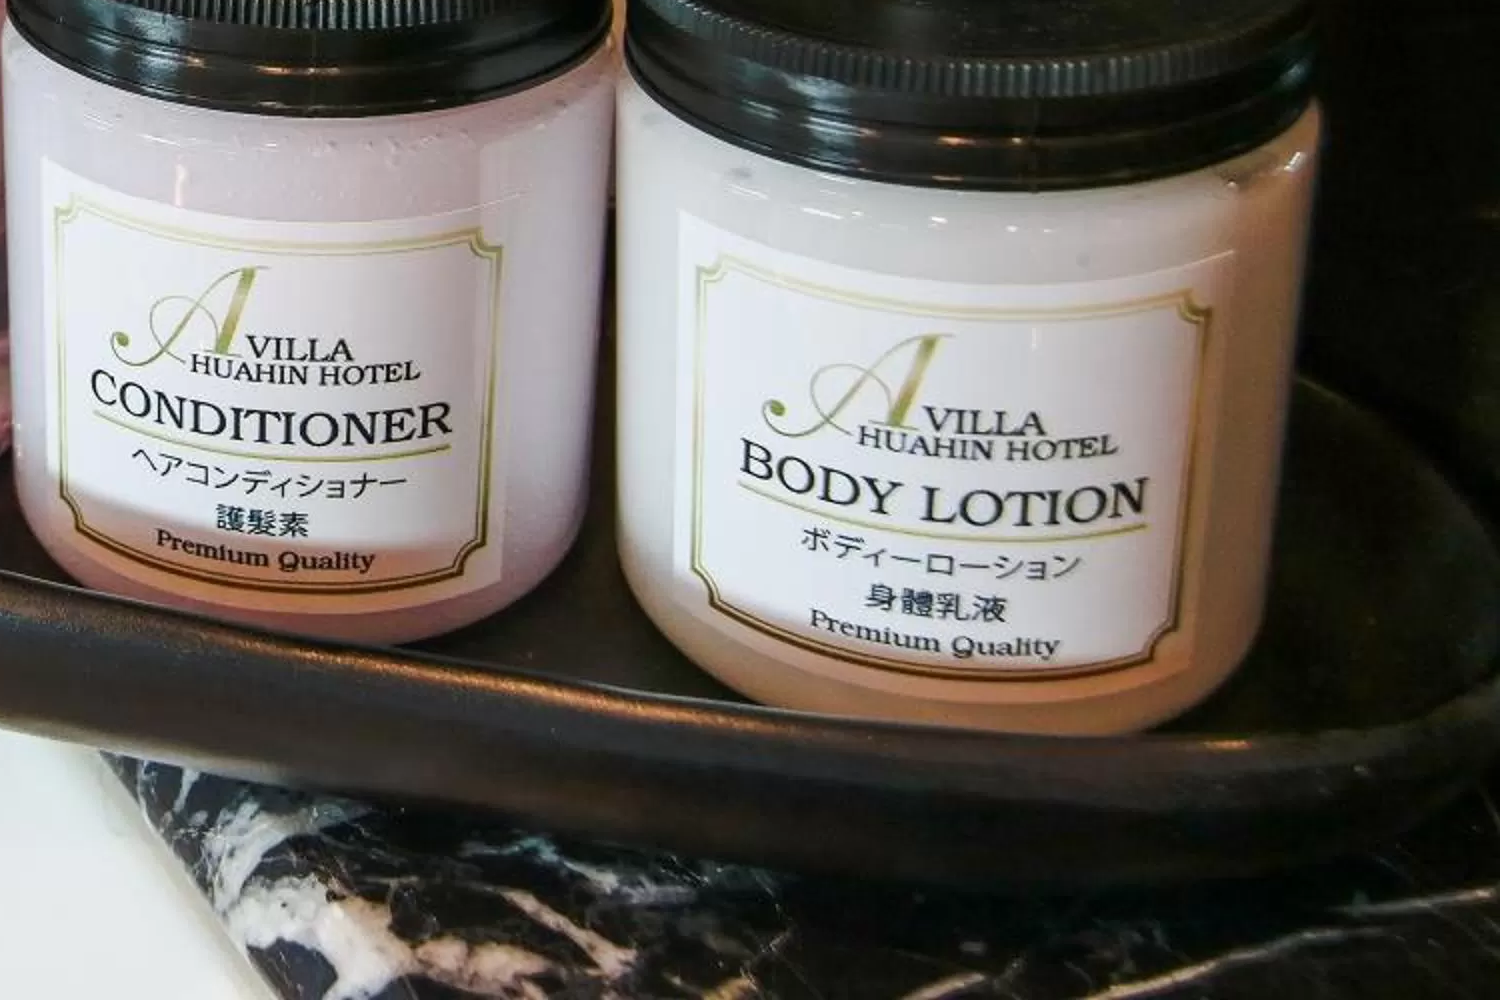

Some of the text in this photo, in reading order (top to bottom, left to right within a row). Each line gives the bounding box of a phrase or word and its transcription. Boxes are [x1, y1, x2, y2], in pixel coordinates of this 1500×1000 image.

[110, 265, 354, 366] A VILLA
[190, 353, 421, 385] HUAHIN HOTEL
[762, 333, 1045, 438] A VILLA
[91, 369, 453, 447] CONDITIONER
[858, 425, 1119, 462] HUAHIN HOTEL
[132, 448, 408, 499] ヘアコンディショナー
[740, 437, 1150, 527] BODY LOTION
[216, 503, 309, 539] 護髮素
[155, 528, 375, 574] Premium Quality
[801, 526, 1082, 581] ボディーローション
[866, 583, 1007, 623] 身體乳液
[810, 608, 1061, 660] Premium Quality
